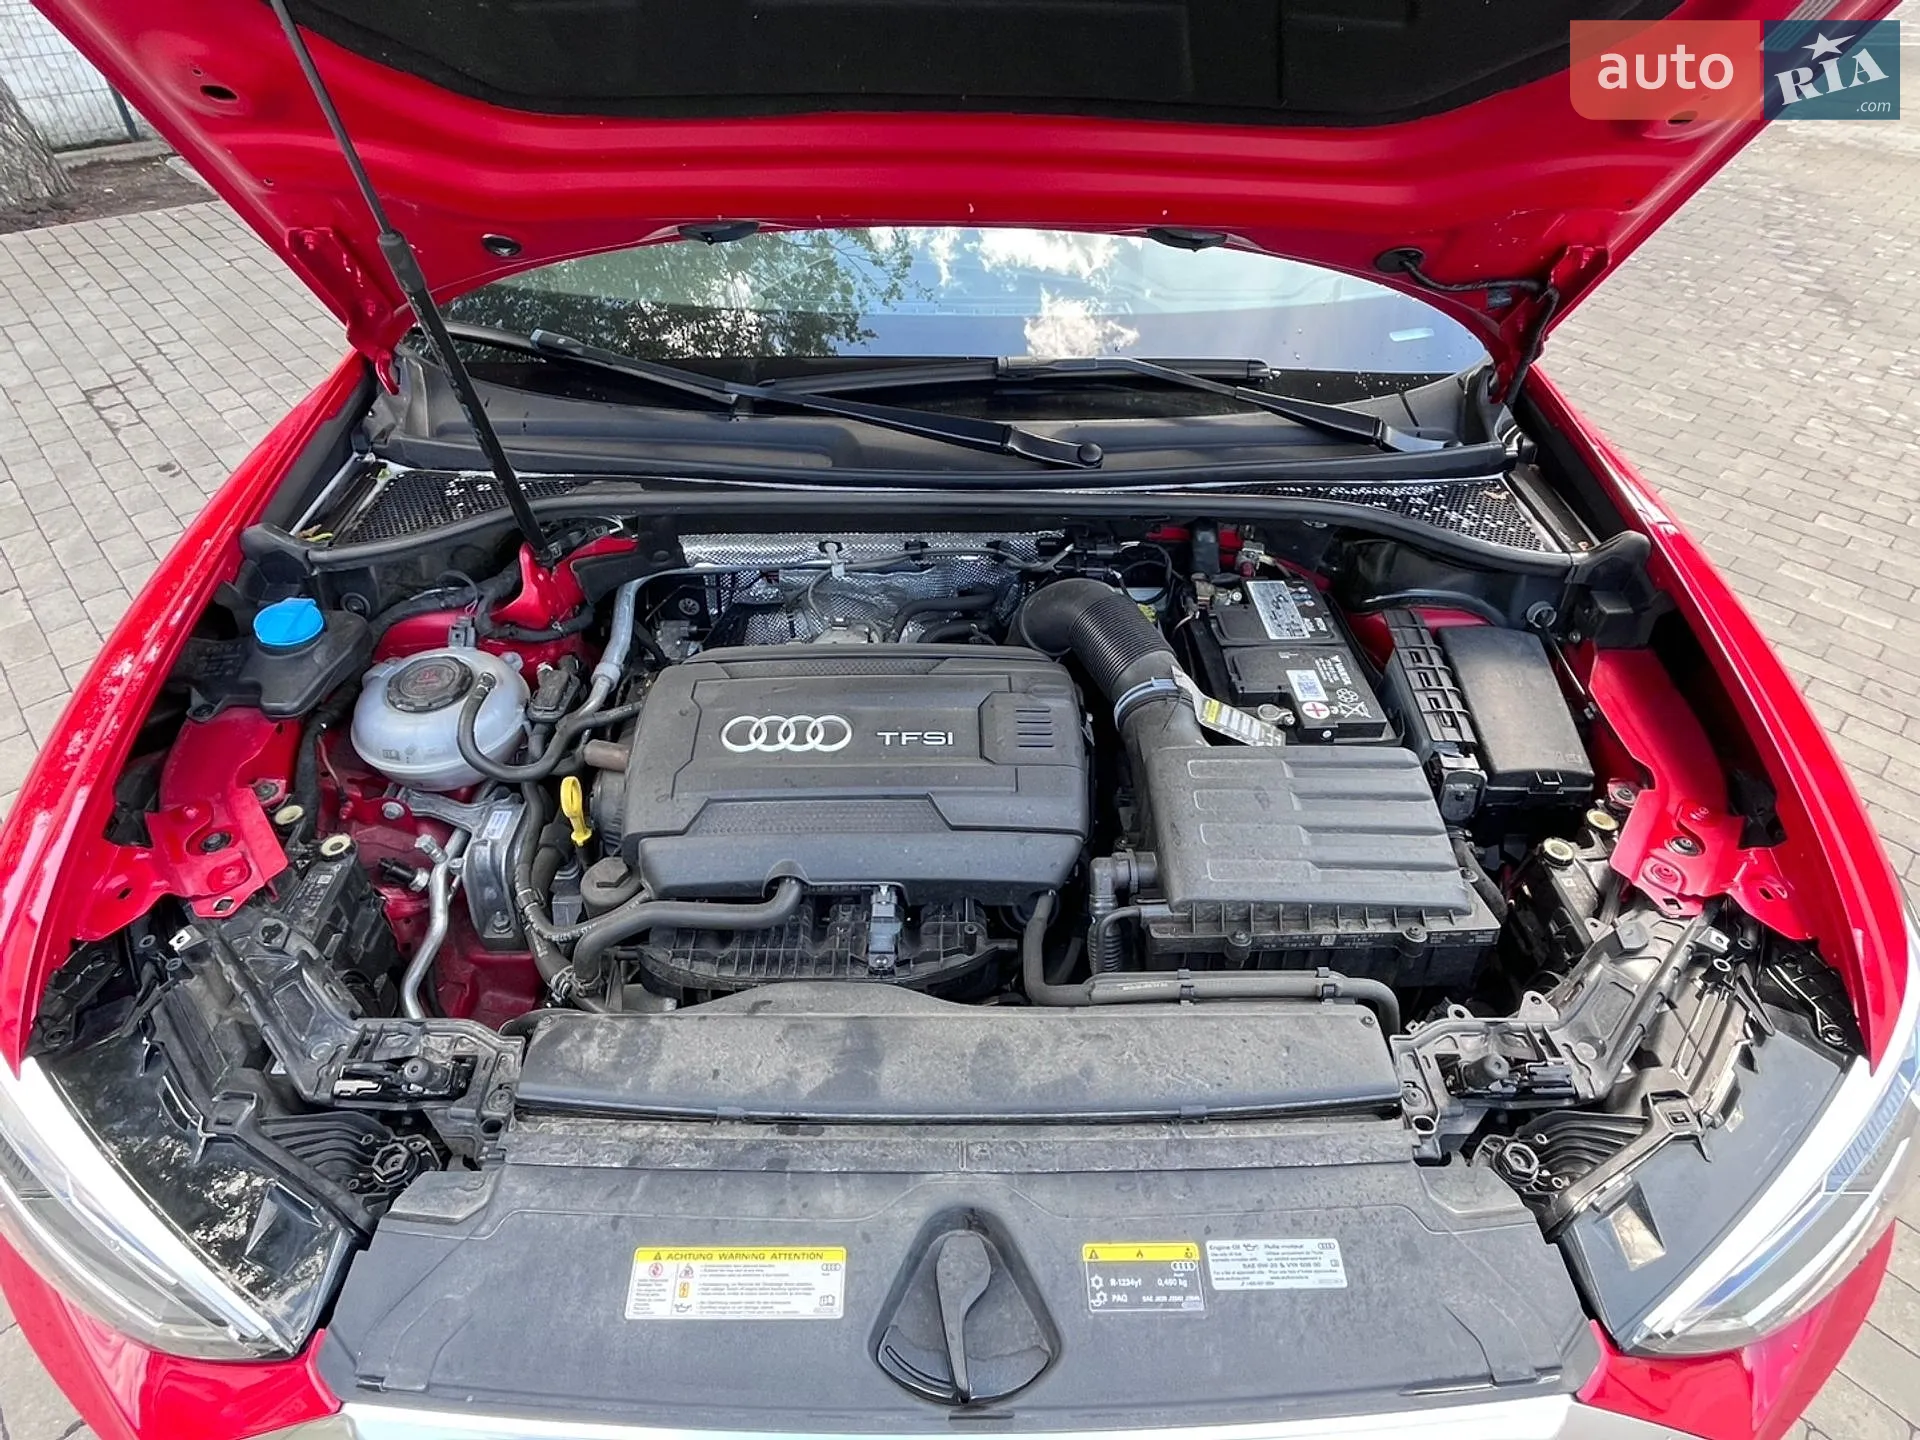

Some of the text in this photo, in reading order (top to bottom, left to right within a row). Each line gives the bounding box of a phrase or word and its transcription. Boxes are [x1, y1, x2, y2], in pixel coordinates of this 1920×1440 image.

[877, 731, 954, 746] TFSI
[666, 1251, 824, 1261] ACHTUNG WARNING ATTENTION
